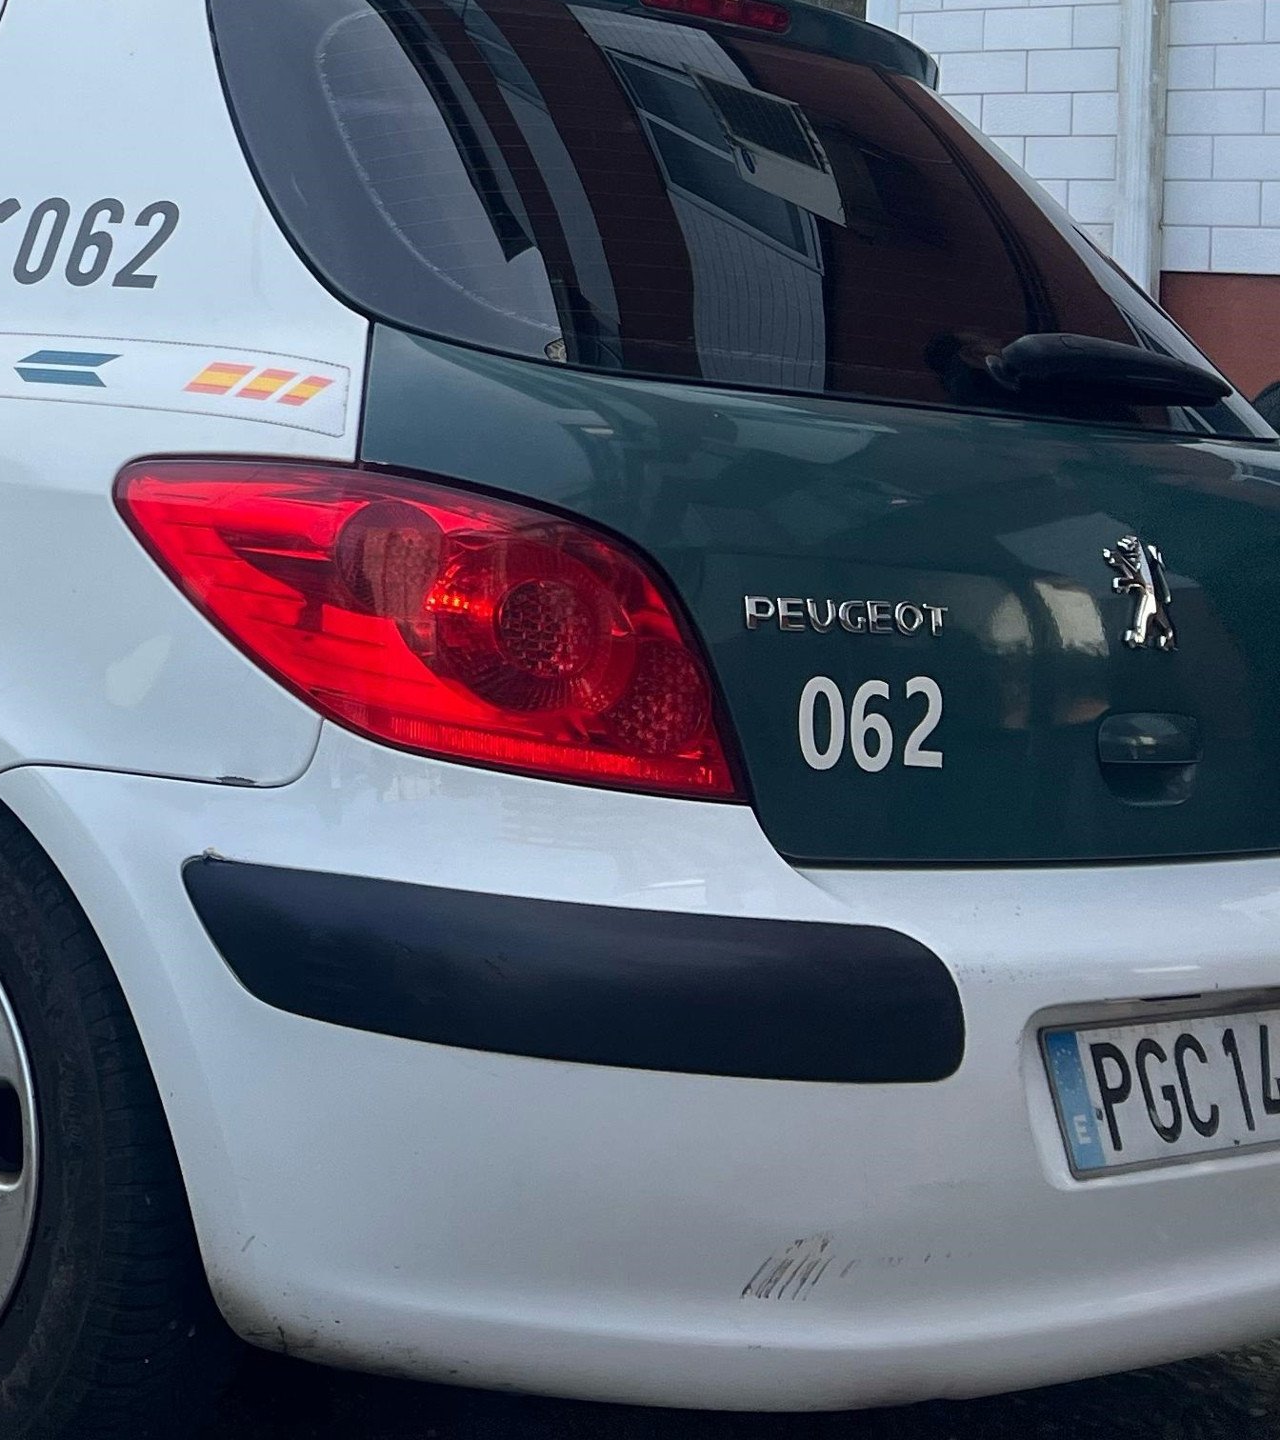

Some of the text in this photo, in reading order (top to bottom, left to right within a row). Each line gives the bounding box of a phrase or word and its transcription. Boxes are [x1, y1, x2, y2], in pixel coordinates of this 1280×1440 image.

[13, 197, 180, 289] 062
[744, 595, 949, 637] PEUGEOT
[798, 675, 943, 773] 062
